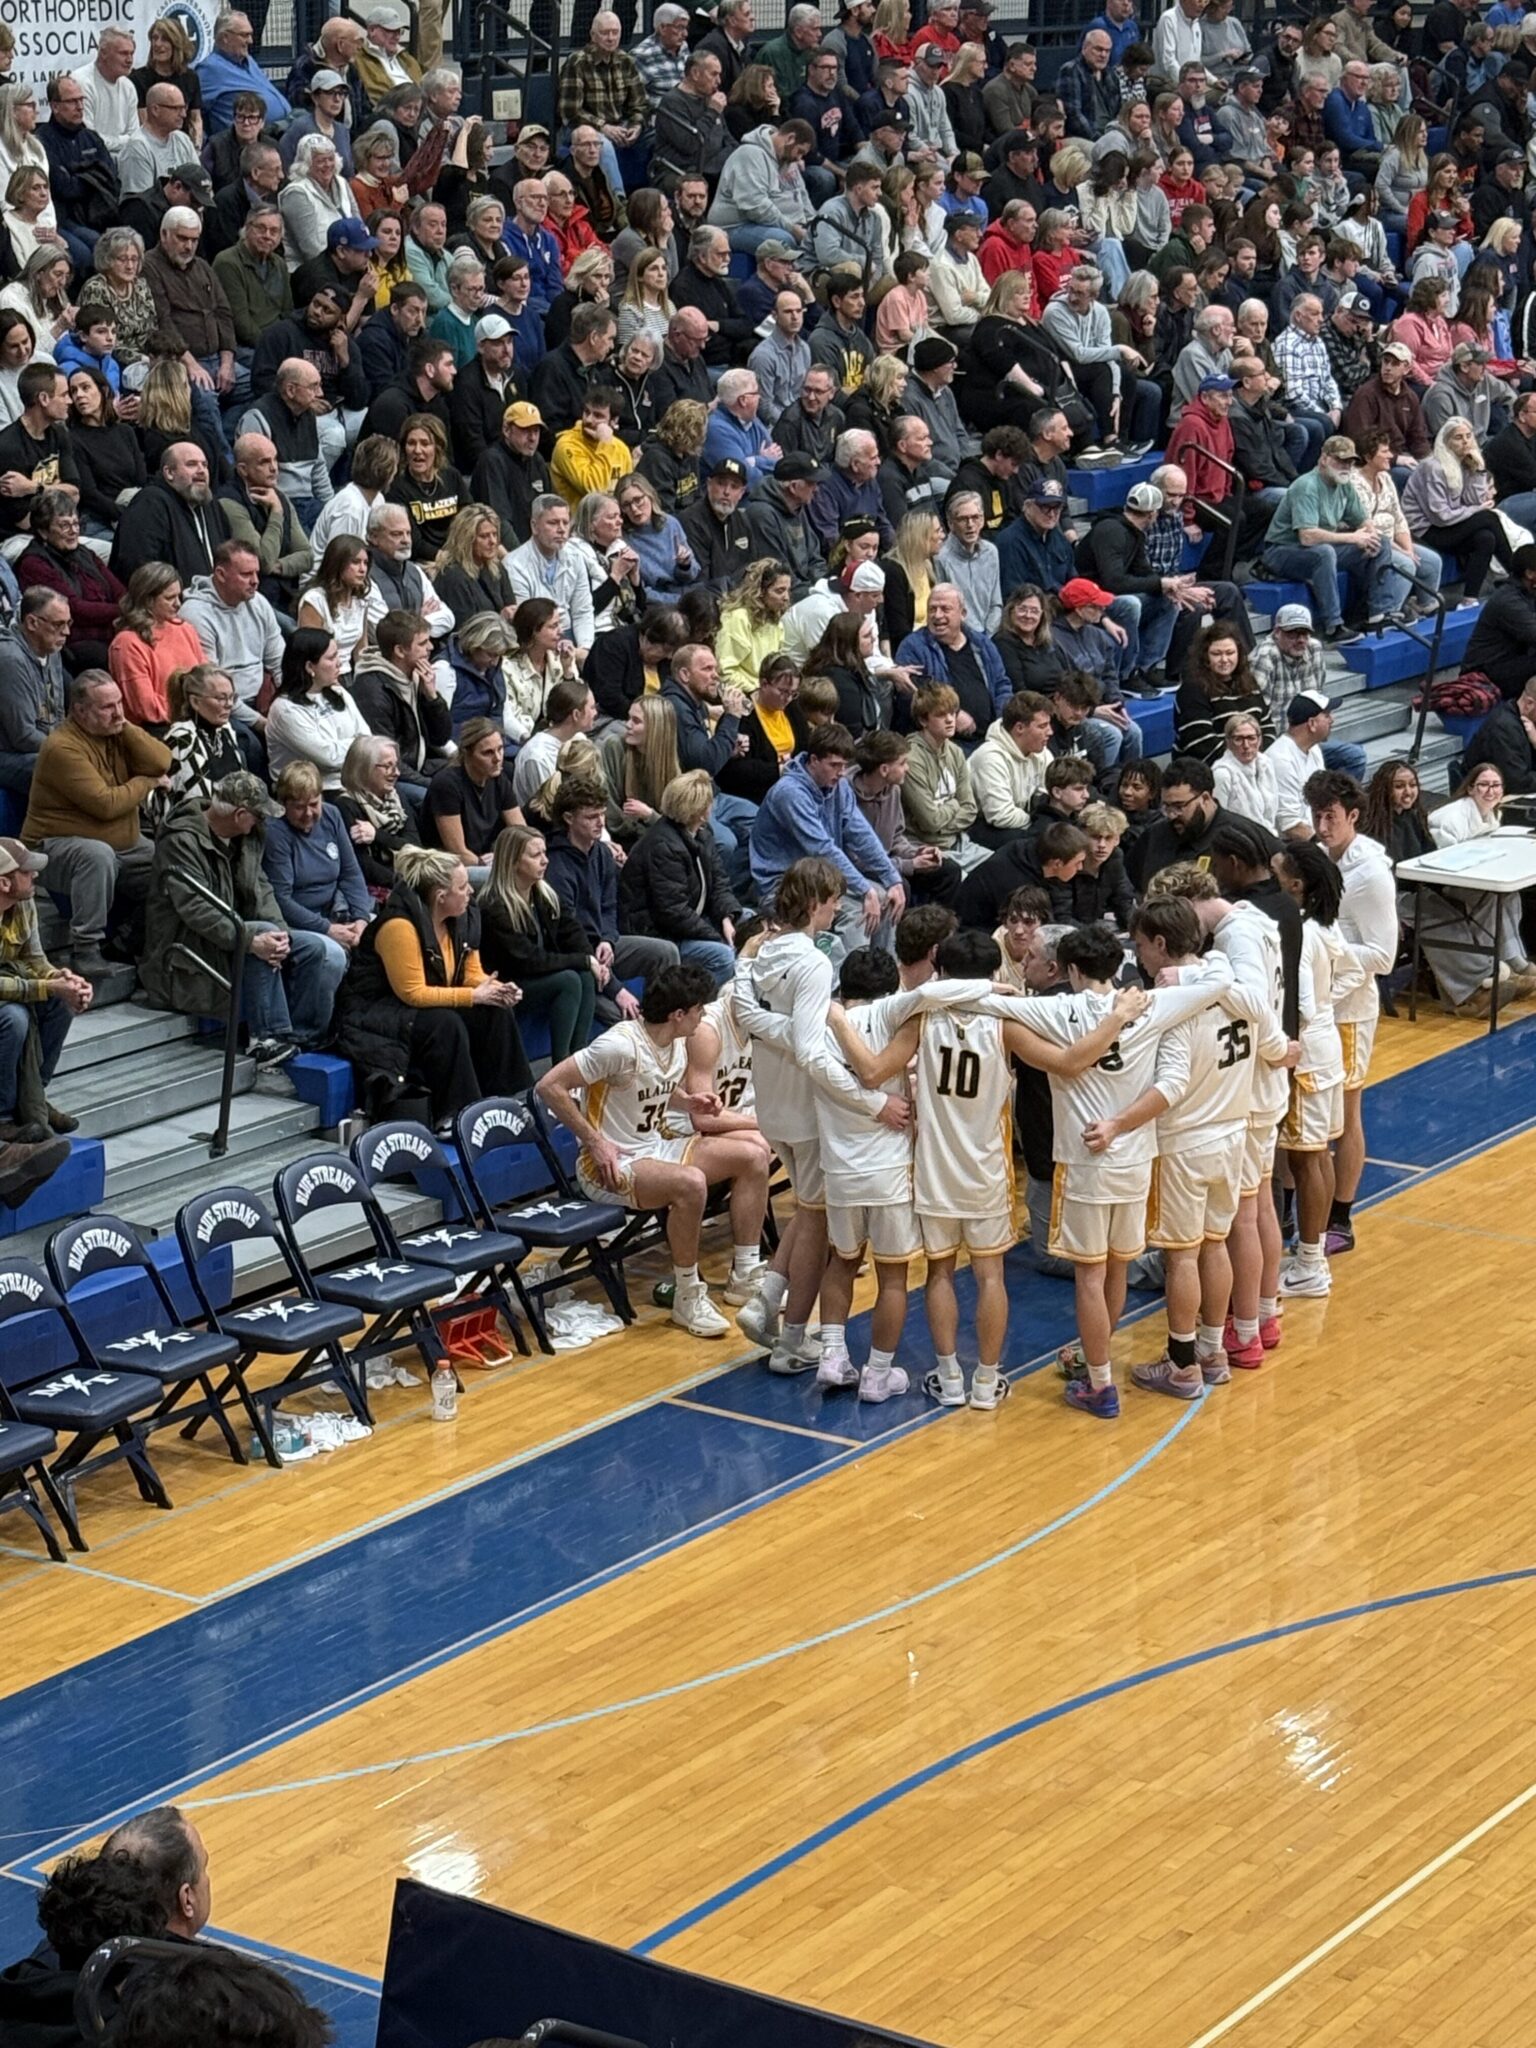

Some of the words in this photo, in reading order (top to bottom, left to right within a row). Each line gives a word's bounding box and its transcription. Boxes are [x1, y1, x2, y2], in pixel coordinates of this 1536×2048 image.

[0, 0, 135, 23] ORTHOPEDIC
[9, 71, 26, 84] OF
[1216, 1018, 1251, 1070] 35
[936, 1044, 981, 1099] 10
[470, 1116, 490, 1149] BLUE
[486, 1109, 526, 1137] STREAKS
[371, 1139, 391, 1173] BLUE
[387, 1132, 433, 1162] STREAKS
[295, 1175, 315, 1207] BLUE
[308, 1165, 357, 1195] STREAKS
[197, 1209, 218, 1244] BLUE
[211, 1200, 261, 1230] STREAKS
[67, 1236, 90, 1273] BLUE
[82, 1228, 133, 1259] STREAKS
